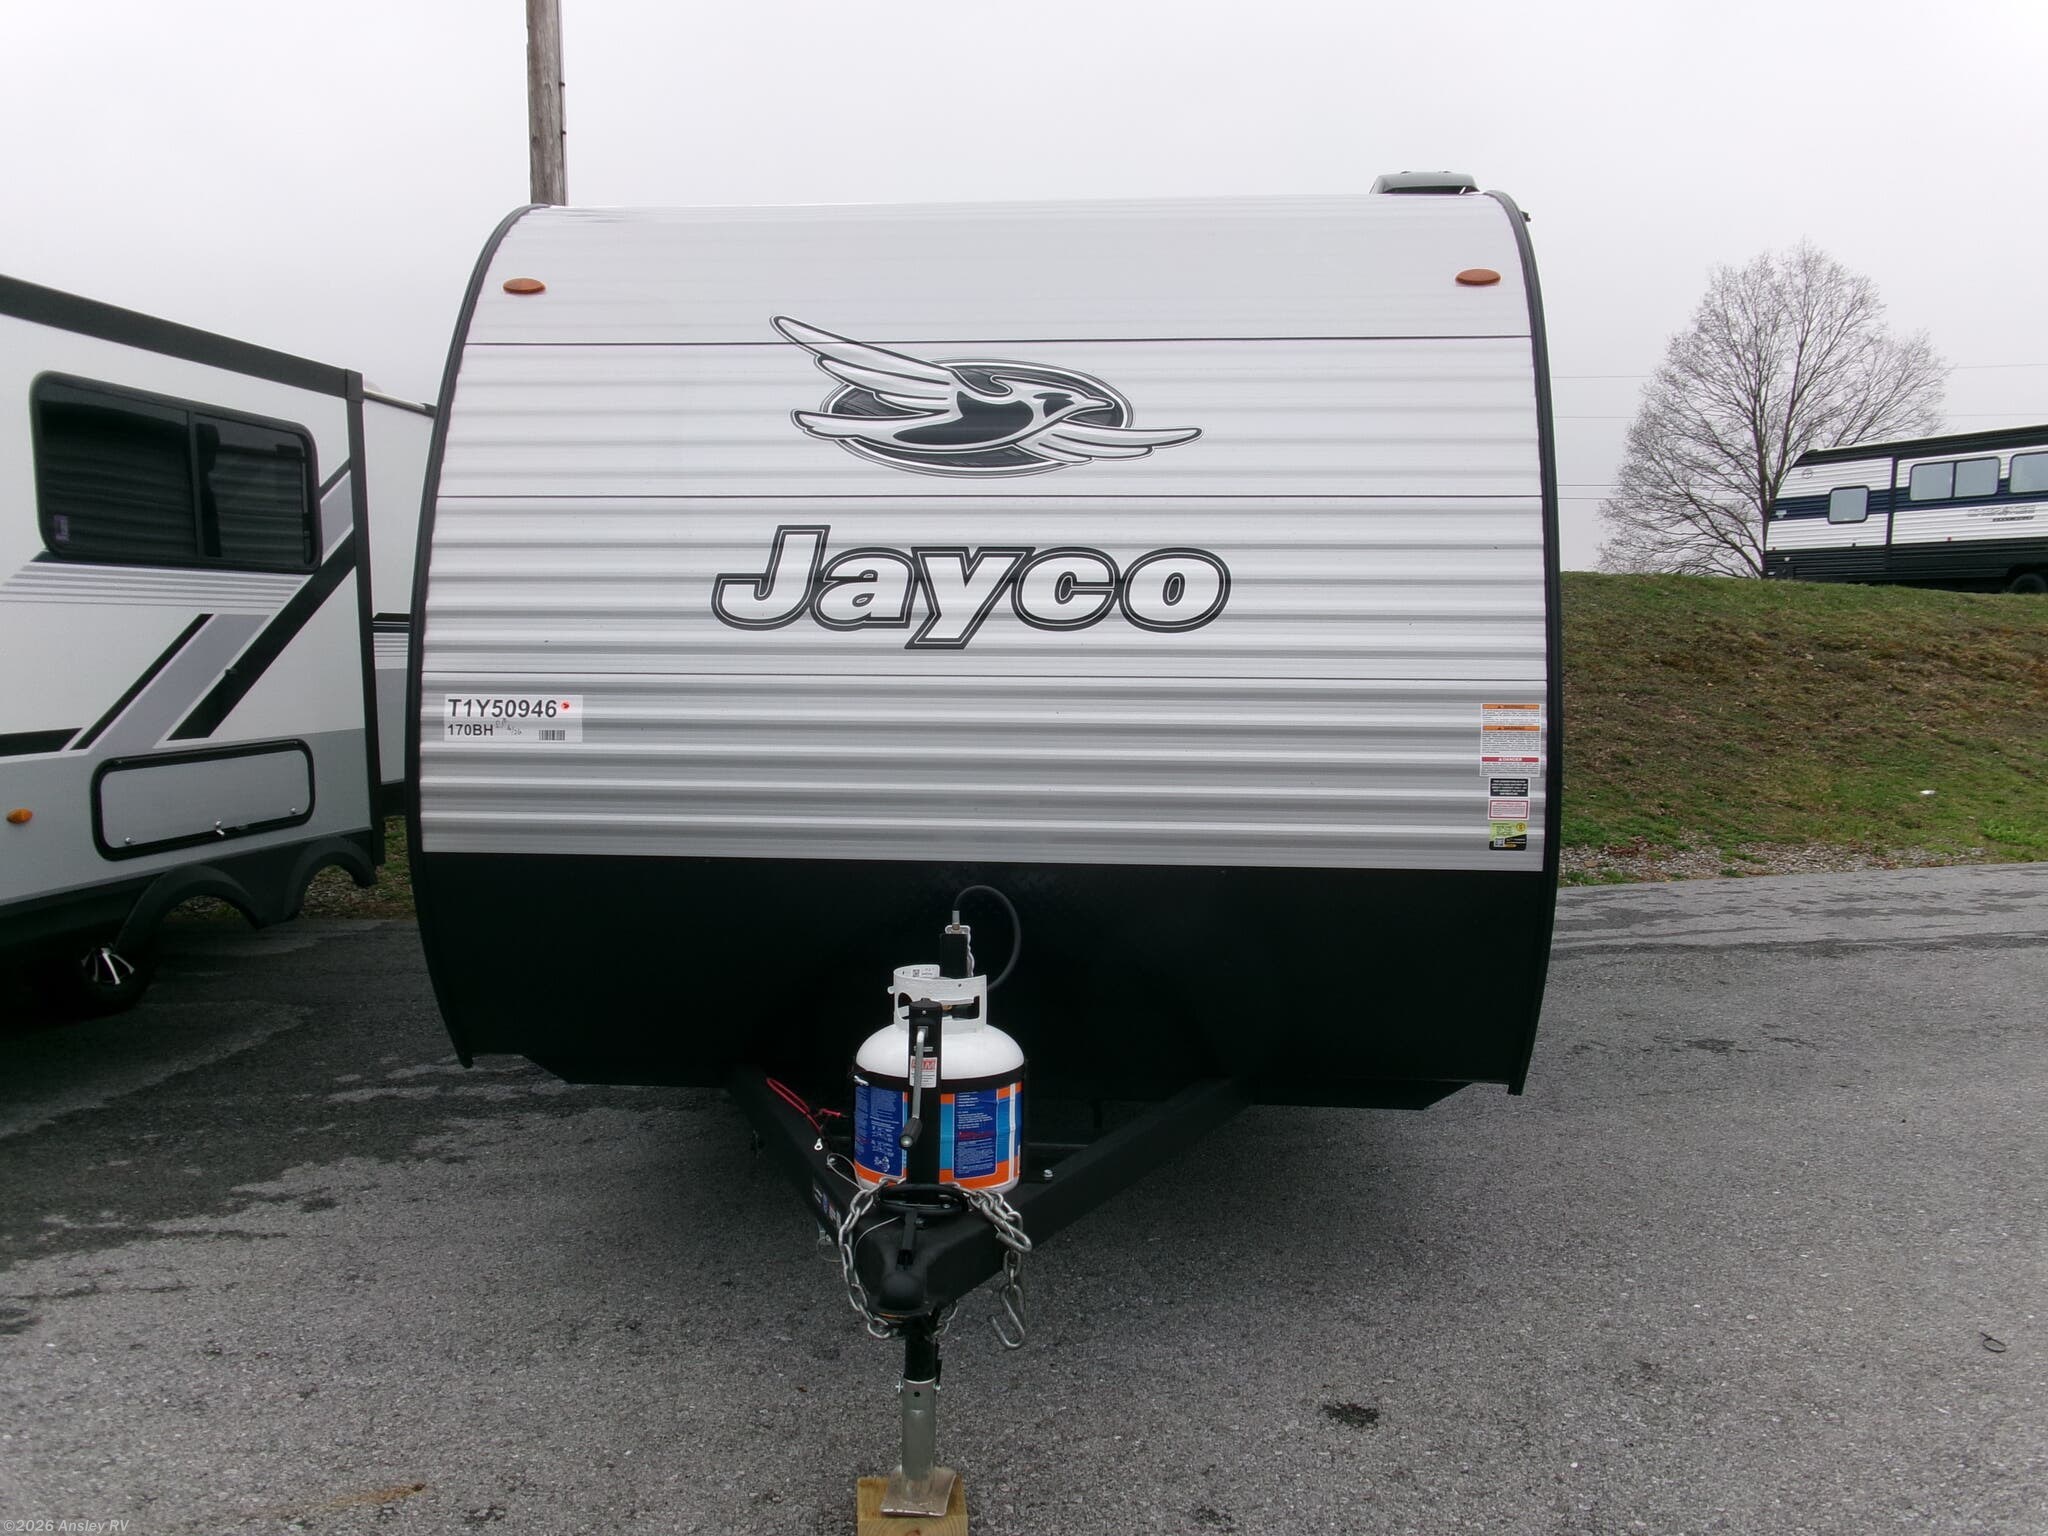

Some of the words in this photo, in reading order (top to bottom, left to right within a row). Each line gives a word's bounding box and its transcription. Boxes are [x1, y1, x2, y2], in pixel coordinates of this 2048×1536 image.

[711, 525, 1232, 650] Jayco
[448, 699, 557, 718] T1Y50946
[447, 724, 494, 736] 170BH
